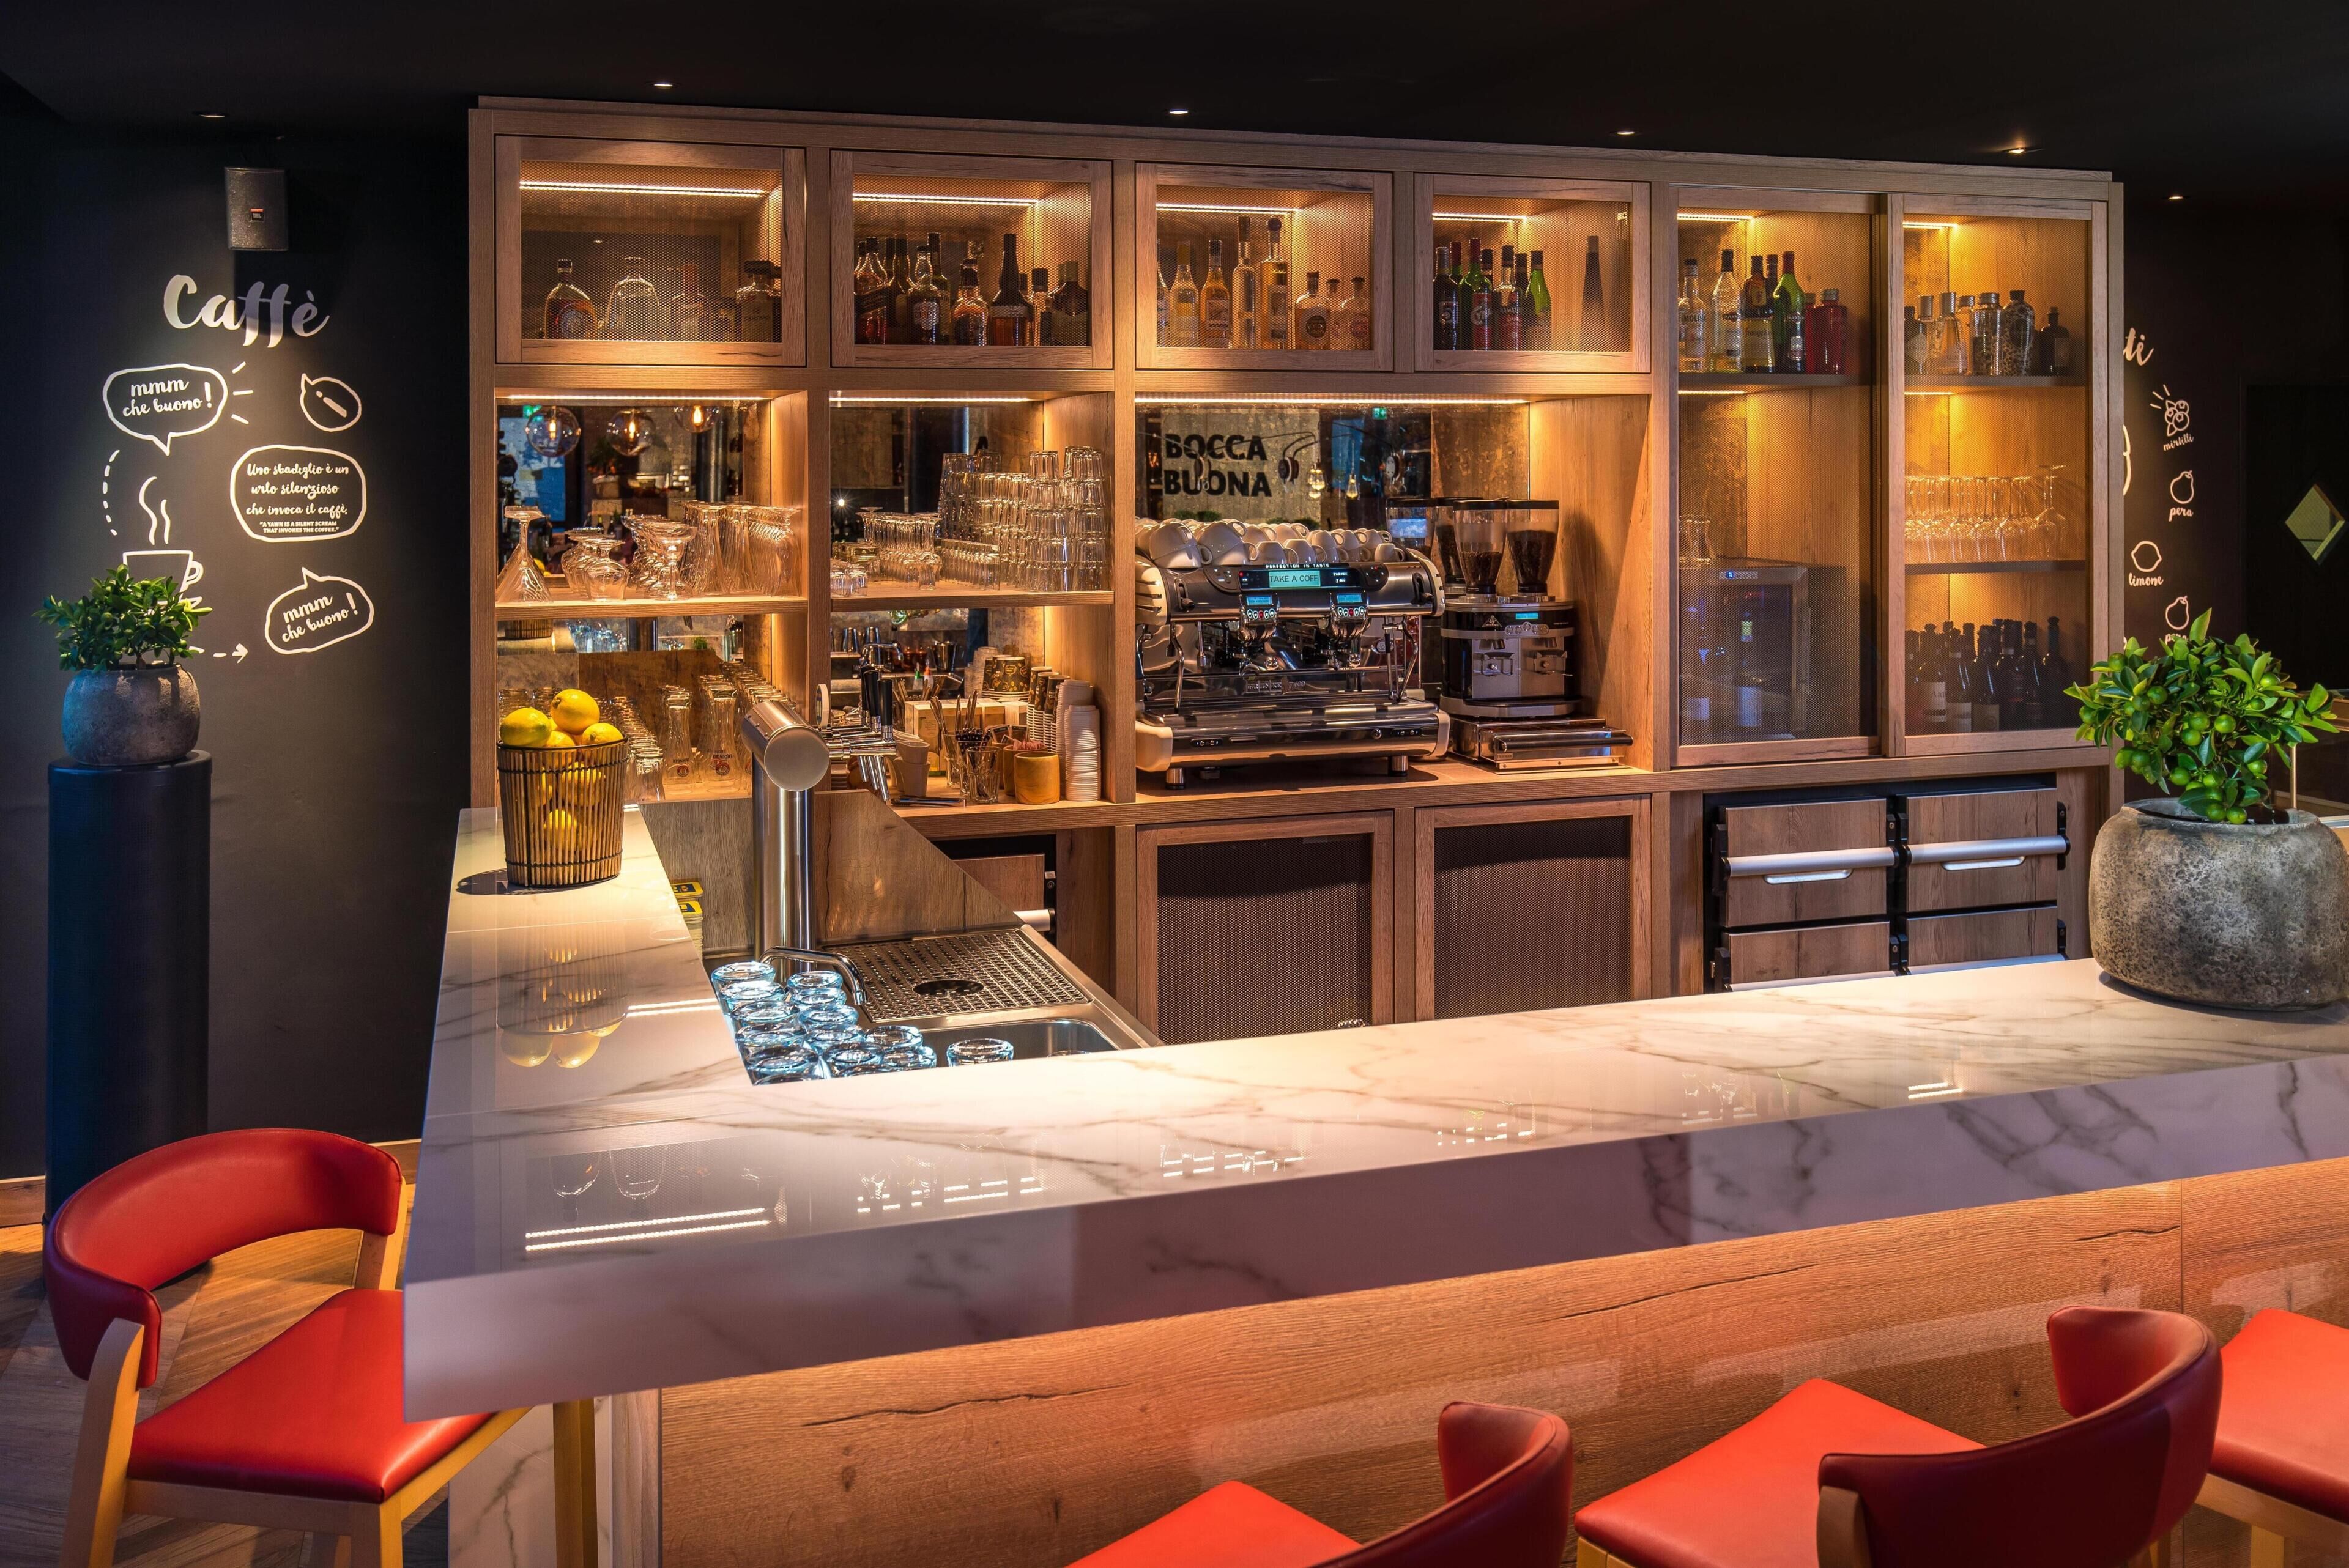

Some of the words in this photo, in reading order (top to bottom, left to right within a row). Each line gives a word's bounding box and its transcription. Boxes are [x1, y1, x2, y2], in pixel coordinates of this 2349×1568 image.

[163, 274, 330, 348] Caffè
[130, 379, 190, 398] mmm
[122, 398, 150, 416] che
[1165, 433, 1268, 461] BOCCA
[2163, 432, 2194, 451] mirtilli
[247, 463, 272, 476] Uno
[273, 462, 324, 479] sbadiglio
[325, 462, 333, 474] è
[335, 466, 349, 475] un
[251, 481, 279, 495] urlo
[281, 481, 340, 500] silenzioso
[1163, 470, 1272, 498] BUONA
[246, 503, 265, 516] che
[268, 505, 304, 516] invoca
[306, 503, 316, 516] il
[2168, 507, 2194, 522] pera
[2128, 572, 2164, 587] limone
[283, 595, 333, 624] mmm
[281, 623, 306, 643] che
